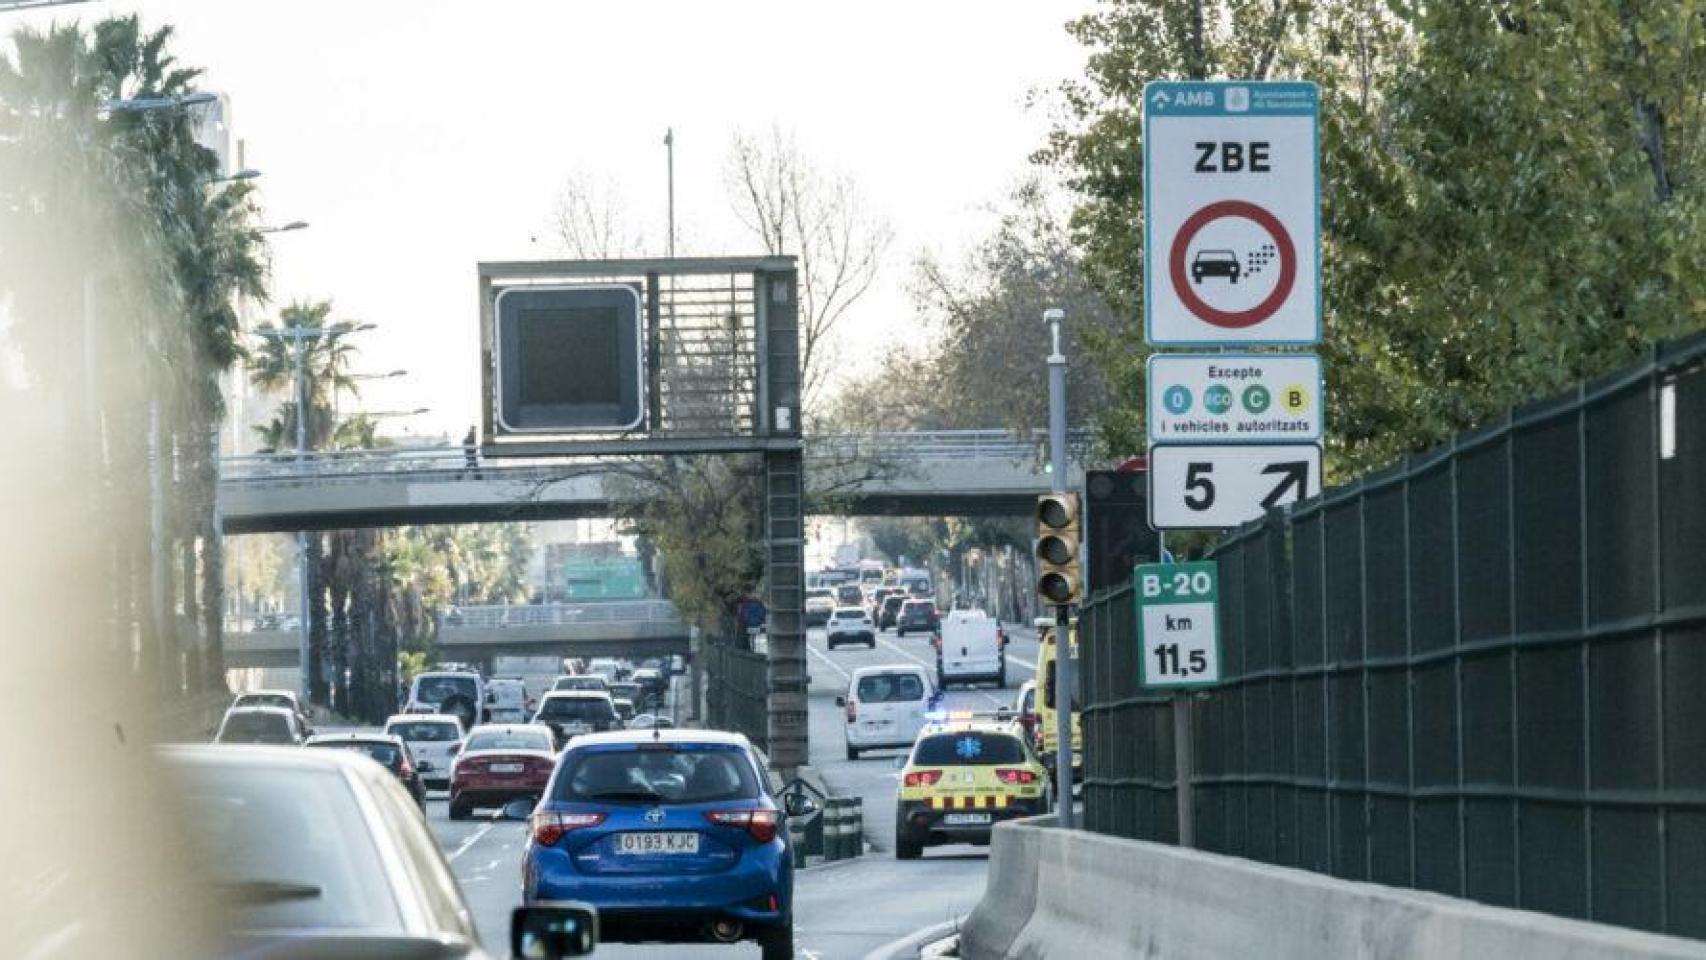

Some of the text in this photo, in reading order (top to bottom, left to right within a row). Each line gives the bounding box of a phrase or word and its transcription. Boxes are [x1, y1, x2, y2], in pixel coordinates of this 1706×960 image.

[1174, 91, 1215, 107] AMB
[1194, 141, 1271, 173] ZBE
[1208, 365, 1264, 380] Excepte
[1249, 391, 1264, 408] C
[1288, 391, 1302, 408] B
[1173, 419, 1230, 433] vehicles
[1237, 419, 1310, 433] autoritzats
[1184, 462, 1216, 511] 5
[1142, 572, 1212, 598] B-20
[1165, 614, 1193, 631] km
[1154, 643, 1207, 677] 11,5
[624, 833, 695, 849] 0193 KJC
